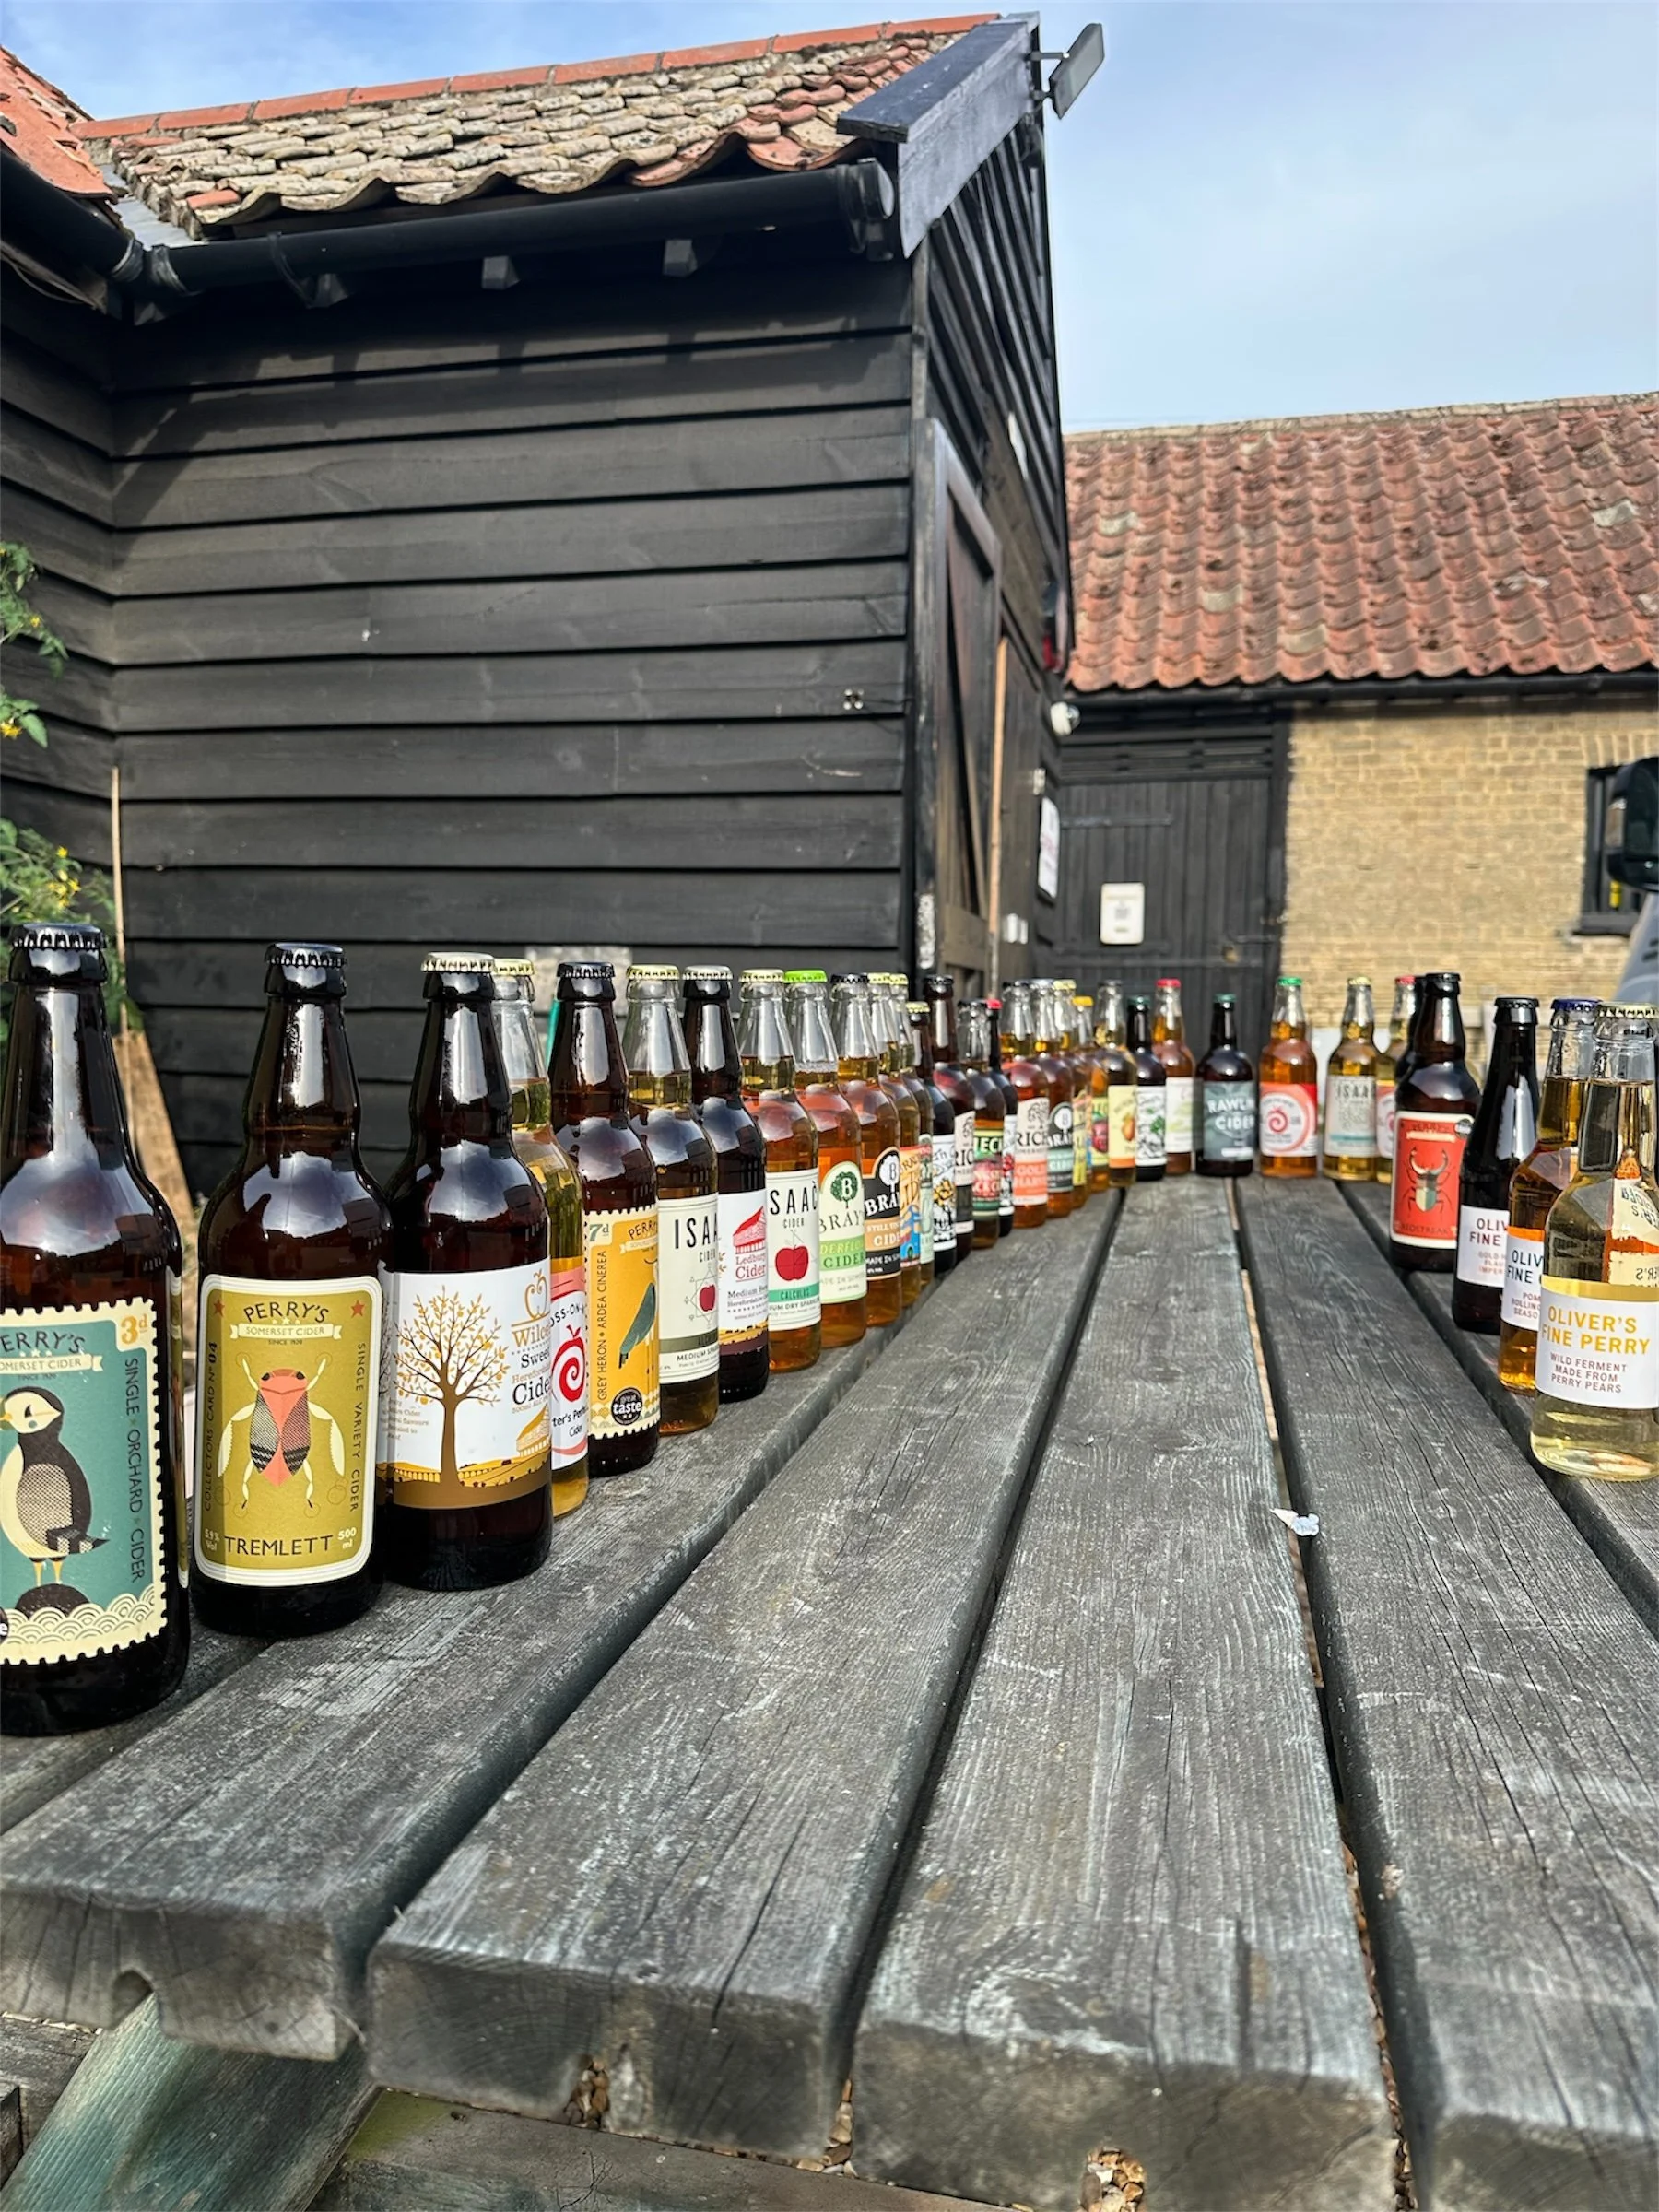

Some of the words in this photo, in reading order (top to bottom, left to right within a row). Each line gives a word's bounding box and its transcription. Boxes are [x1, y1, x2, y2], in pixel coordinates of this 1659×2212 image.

[865, 1192, 900, 1217] BRA
[783, 1218, 804, 1229] CIDER
[819, 1210, 864, 1233] BRAY
[1469, 1231, 1500, 1246] FINE
[596, 1250, 607, 1292] CINEREA
[735, 1264, 766, 1279] Cider
[1507, 1265, 1534, 1284] FINE
[728, 1288, 758, 1299] Medium
[243, 1300, 330, 1324] PERRY'S
[596, 1295, 607, 1328] ARDEA
[1548, 1305, 1637, 1334] OLIVER'S
[246, 1326, 292, 1336] SOMERSET
[296, 1326, 325, 1336] CIDER
[1541, 1324, 1572, 1347] FINE
[1580, 1334, 1650, 1355] PERRY
[47, 1358, 82, 1369] CIDER
[208, 1342, 218, 1364] 04
[596, 1340, 607, 1370] HERON
[677, 1349, 706, 1361] MEDIUM
[1550, 1352, 1572, 1366] WILD
[1575, 1359, 1628, 1372] FERMENT
[356, 1342, 366, 1392] SINGLE
[1555, 1365, 1583, 1378] MADE
[1585, 1371, 1618, 1382] FROM
[125, 1358, 140, 1416] SINGLE
[512, 1376, 550, 1406] Cide
[597, 1377, 607, 1401] GREY
[1551, 1374, 1582, 1388] PERRY
[1585, 1381, 1622, 1394] PEARS
[206, 1386, 215, 1421] CARD
[613, 1401, 642, 1415] taste
[352, 1401, 363, 1459] VARIETY
[127, 1429, 144, 1513] ORCHARD
[204, 1429, 214, 1512] COLLECTORS
[349, 1469, 360, 1512] CIDER
[224, 1535, 333, 1556] TREMLETT
[337, 1527, 357, 1541] 500
[342, 1540, 353, 1549] ml
[130, 1528, 146, 1583] CIDER
